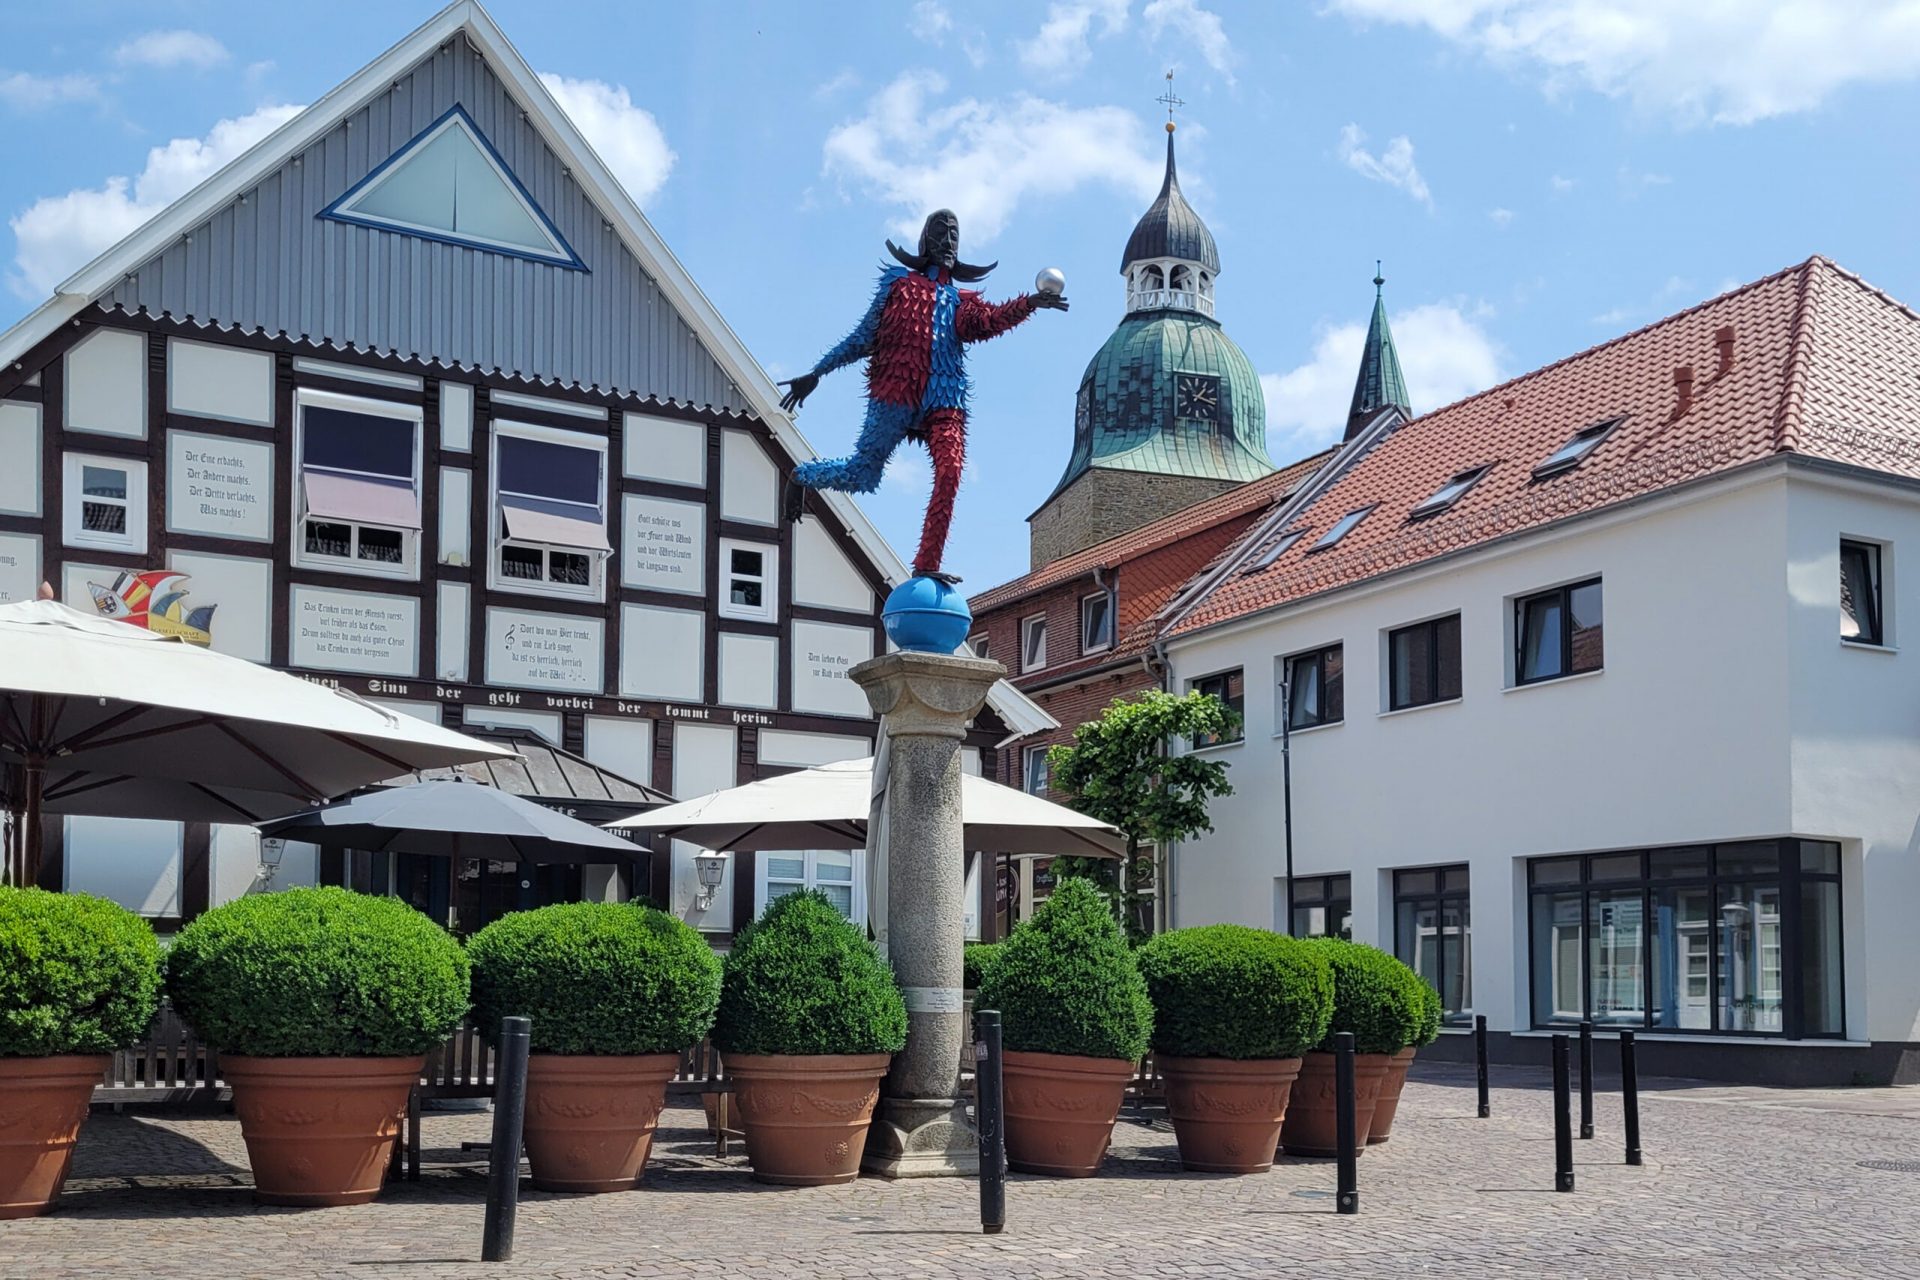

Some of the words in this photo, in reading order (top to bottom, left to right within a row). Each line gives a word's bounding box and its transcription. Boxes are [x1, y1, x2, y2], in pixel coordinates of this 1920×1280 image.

[185, 450, 199, 462] Der
[187, 467, 201, 480] Der
[189, 485, 203, 496] Der
[368, 679, 408, 695] Sinn
[436, 685, 461, 699] der
[488, 692, 521, 706] geht
[547, 696, 594, 710] vorbei
[618, 701, 641, 714] der
[665, 703, 709, 719] kommt
